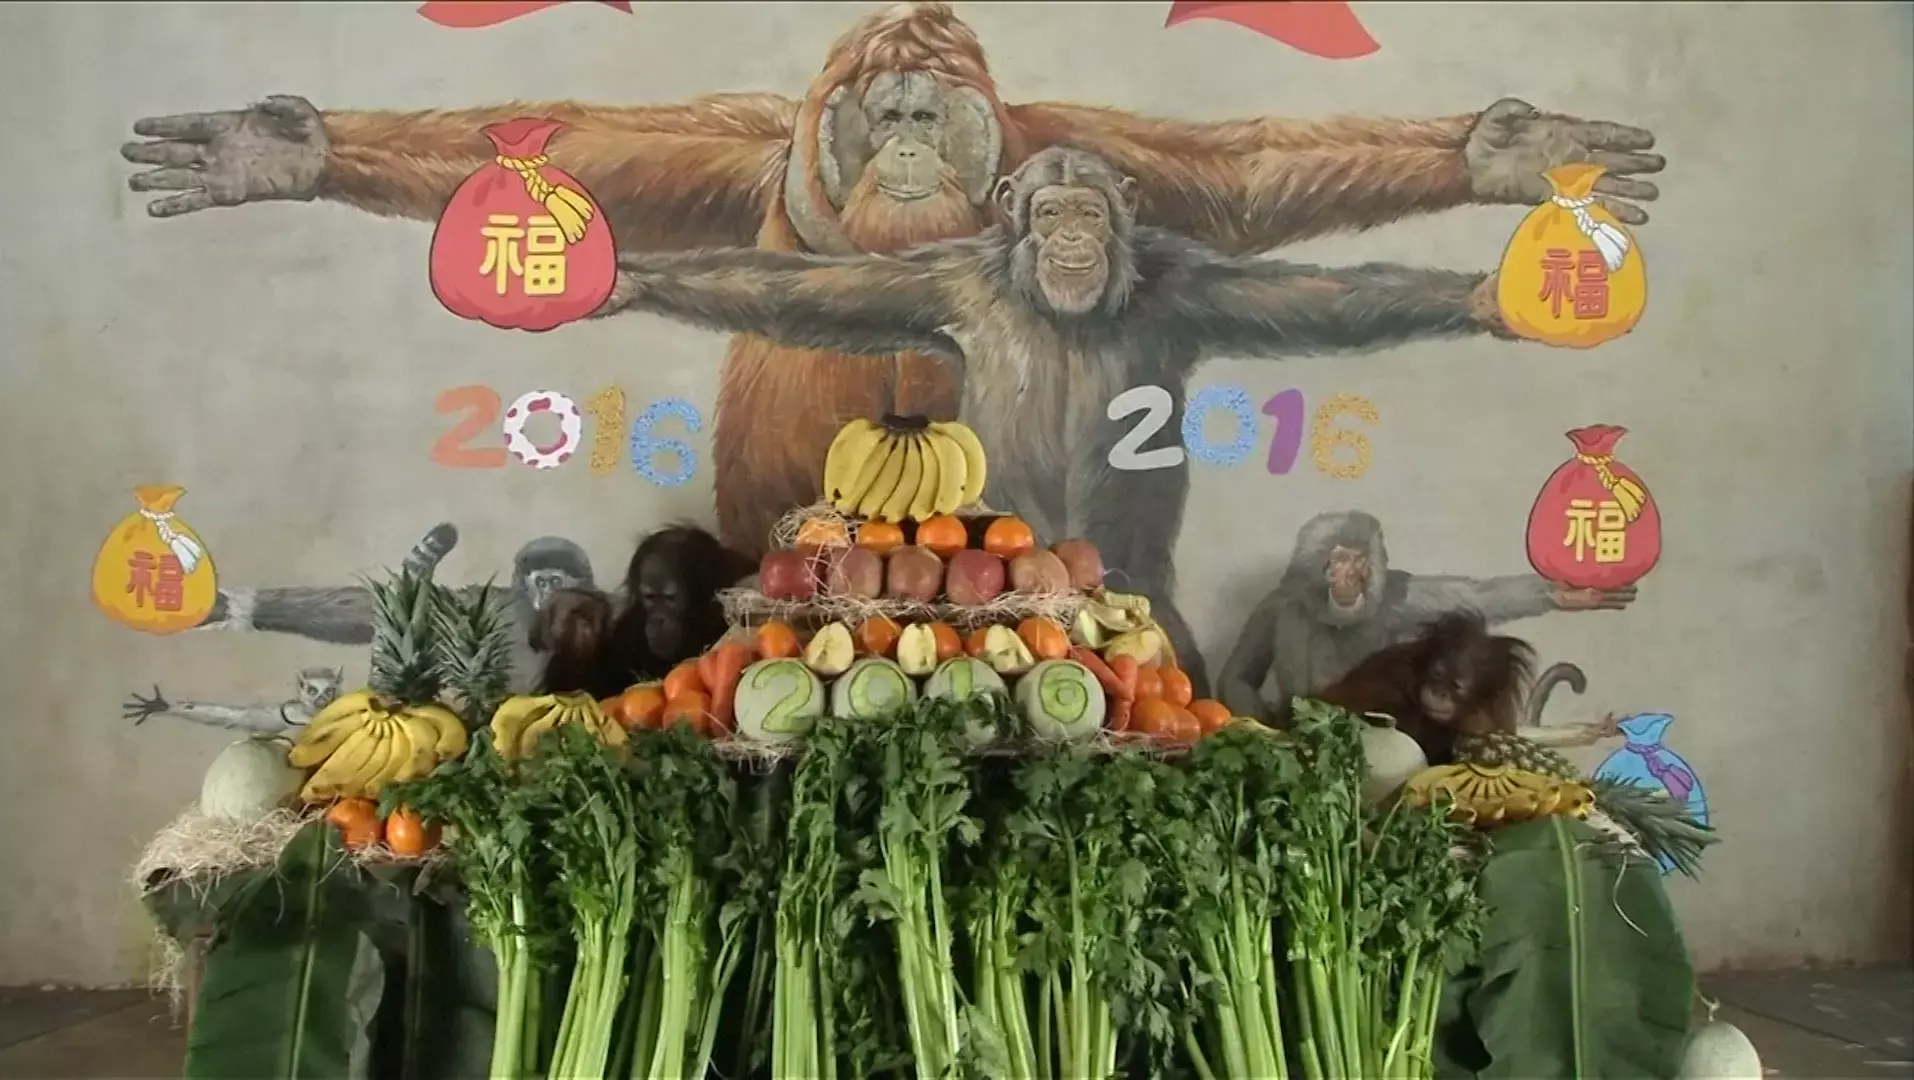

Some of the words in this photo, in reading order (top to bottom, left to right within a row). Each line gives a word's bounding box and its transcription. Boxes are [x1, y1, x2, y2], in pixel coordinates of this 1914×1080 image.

[479, 214, 566, 295] 福
[1538, 249, 1609, 319] 福
[431, 384, 703, 488] 2016
[1107, 385, 1380, 480] 2016
[1563, 499, 1626, 563] 福
[126, 551, 183, 612] 福
